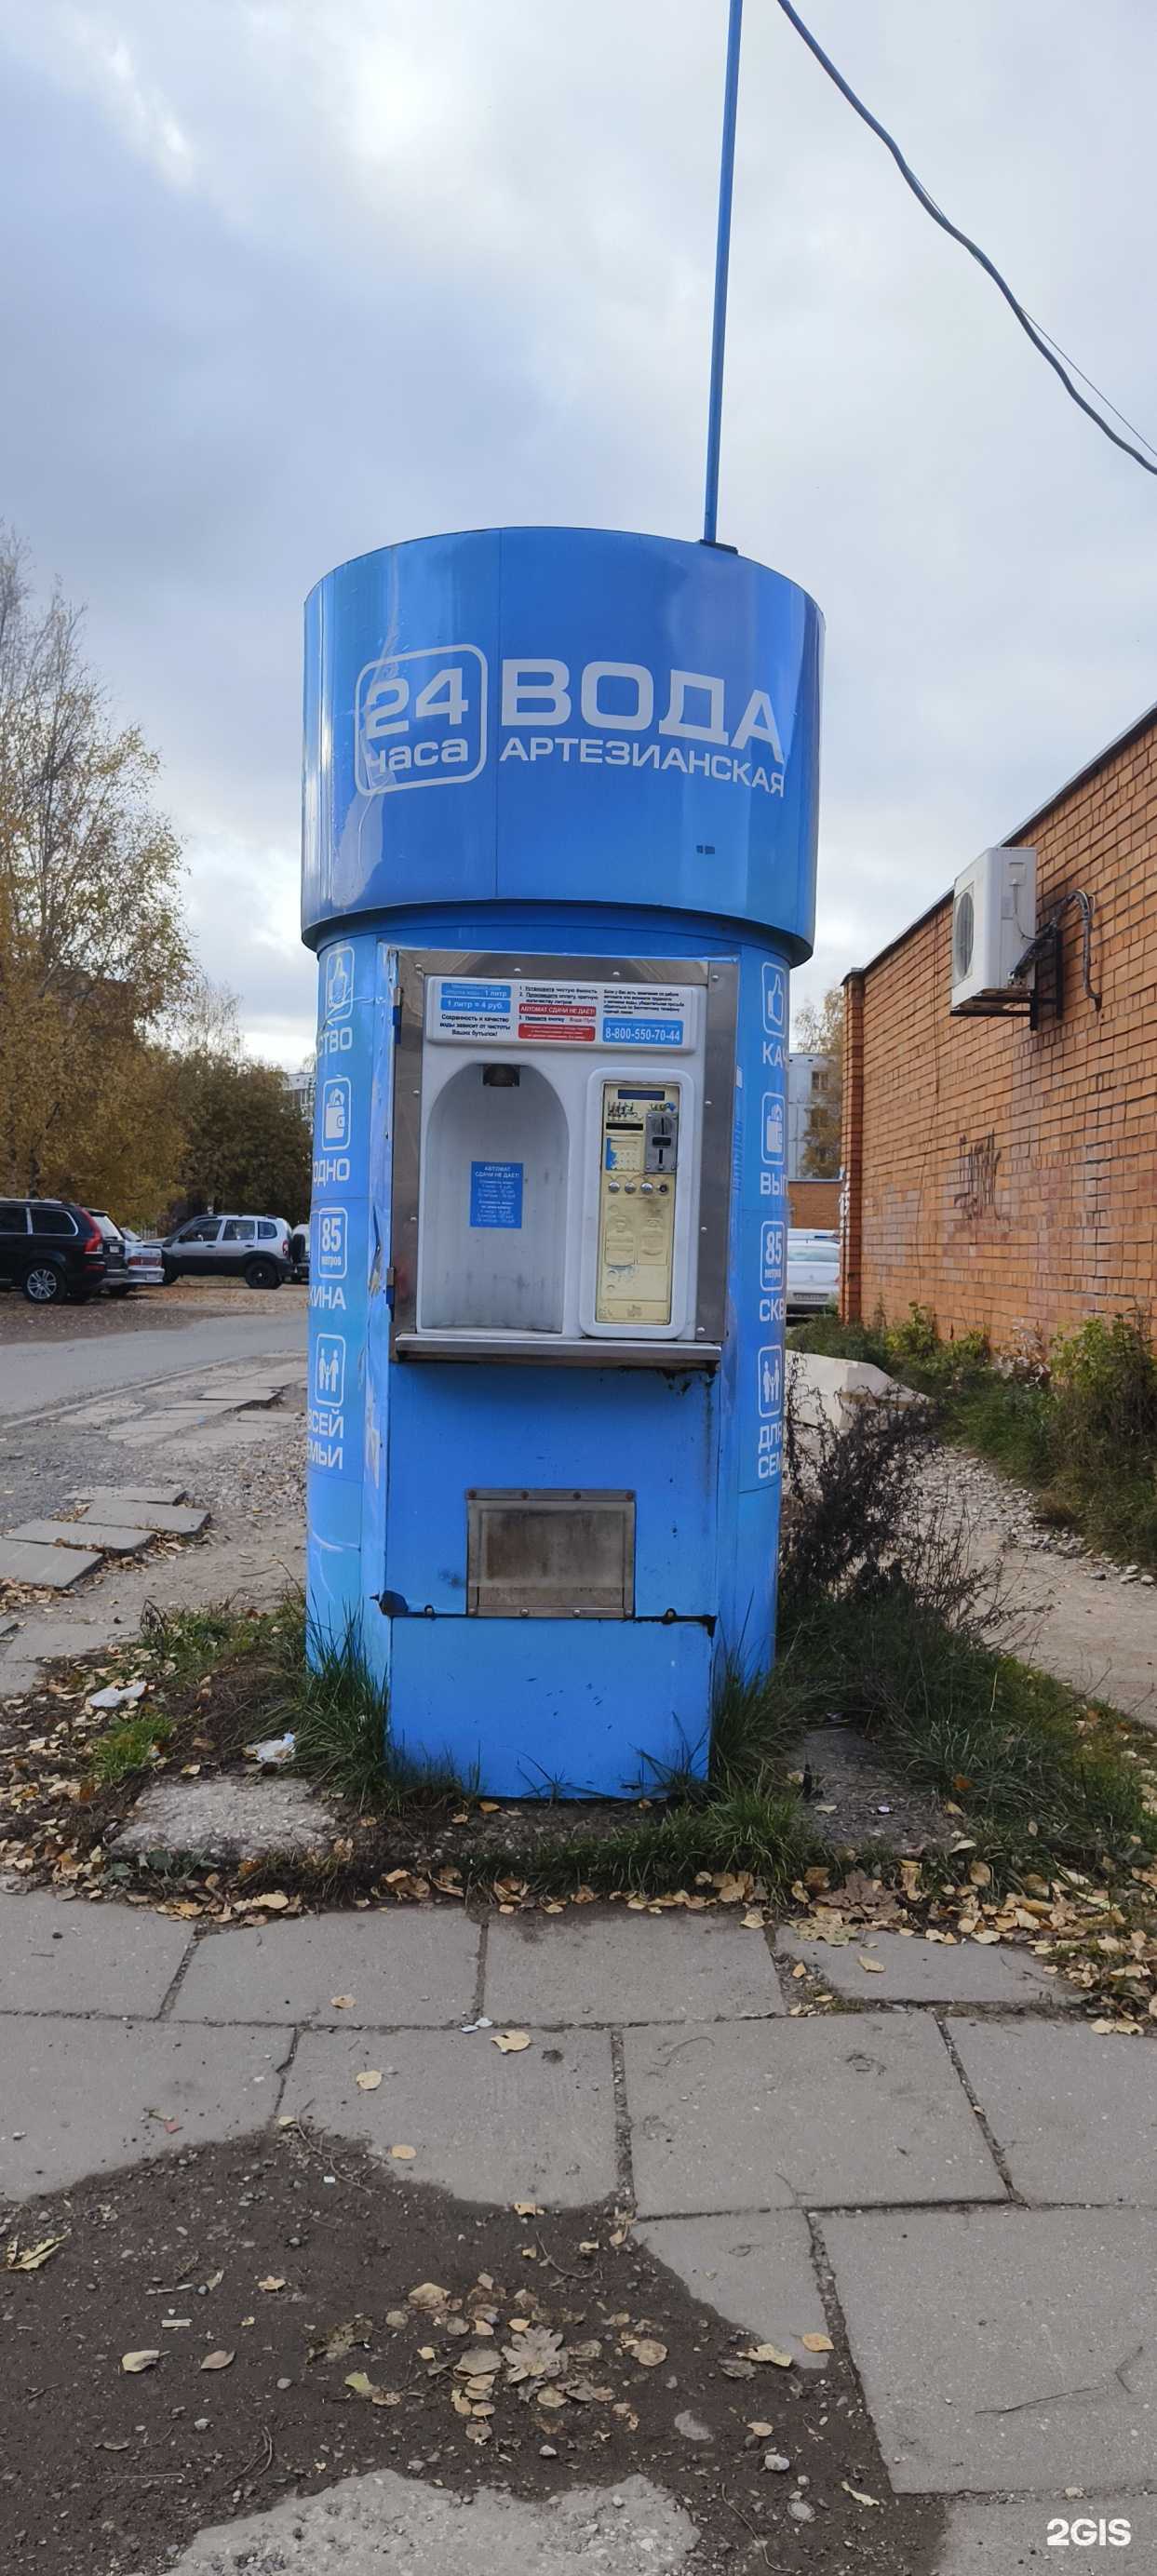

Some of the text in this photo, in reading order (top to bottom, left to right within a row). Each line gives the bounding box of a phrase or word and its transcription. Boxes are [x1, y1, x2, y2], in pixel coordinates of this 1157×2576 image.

[366, 667, 469, 739] 24
[501, 658, 784, 765] ВОДА
[364, 738, 468, 775] часа
[500, 736, 784, 798] АРТЕЗИАНСКАЯ
[605, 1026, 680, 1041] 8-800-550-70-44
[321, 1217, 343, 1252] 85
[765, 1230, 783, 1265] 85
